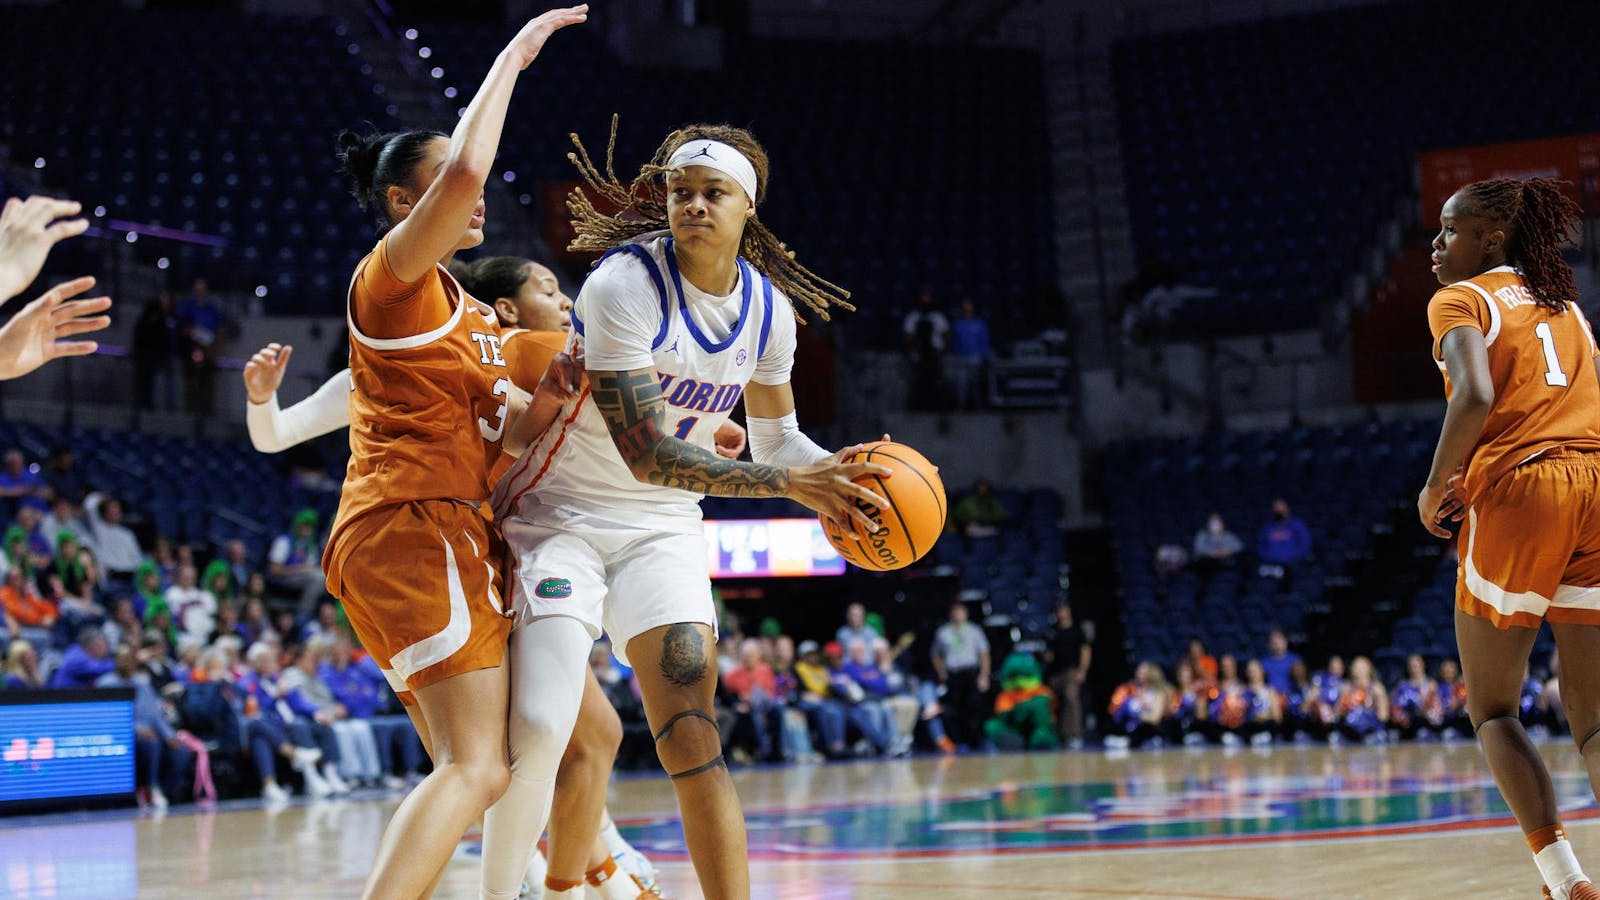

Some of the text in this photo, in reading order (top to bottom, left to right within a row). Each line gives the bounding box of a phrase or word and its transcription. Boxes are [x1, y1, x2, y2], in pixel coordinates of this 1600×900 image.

[1493, 285, 1552, 312] PRES
[1534, 321, 1568, 388] 1
[674, 416, 699, 440] 1
